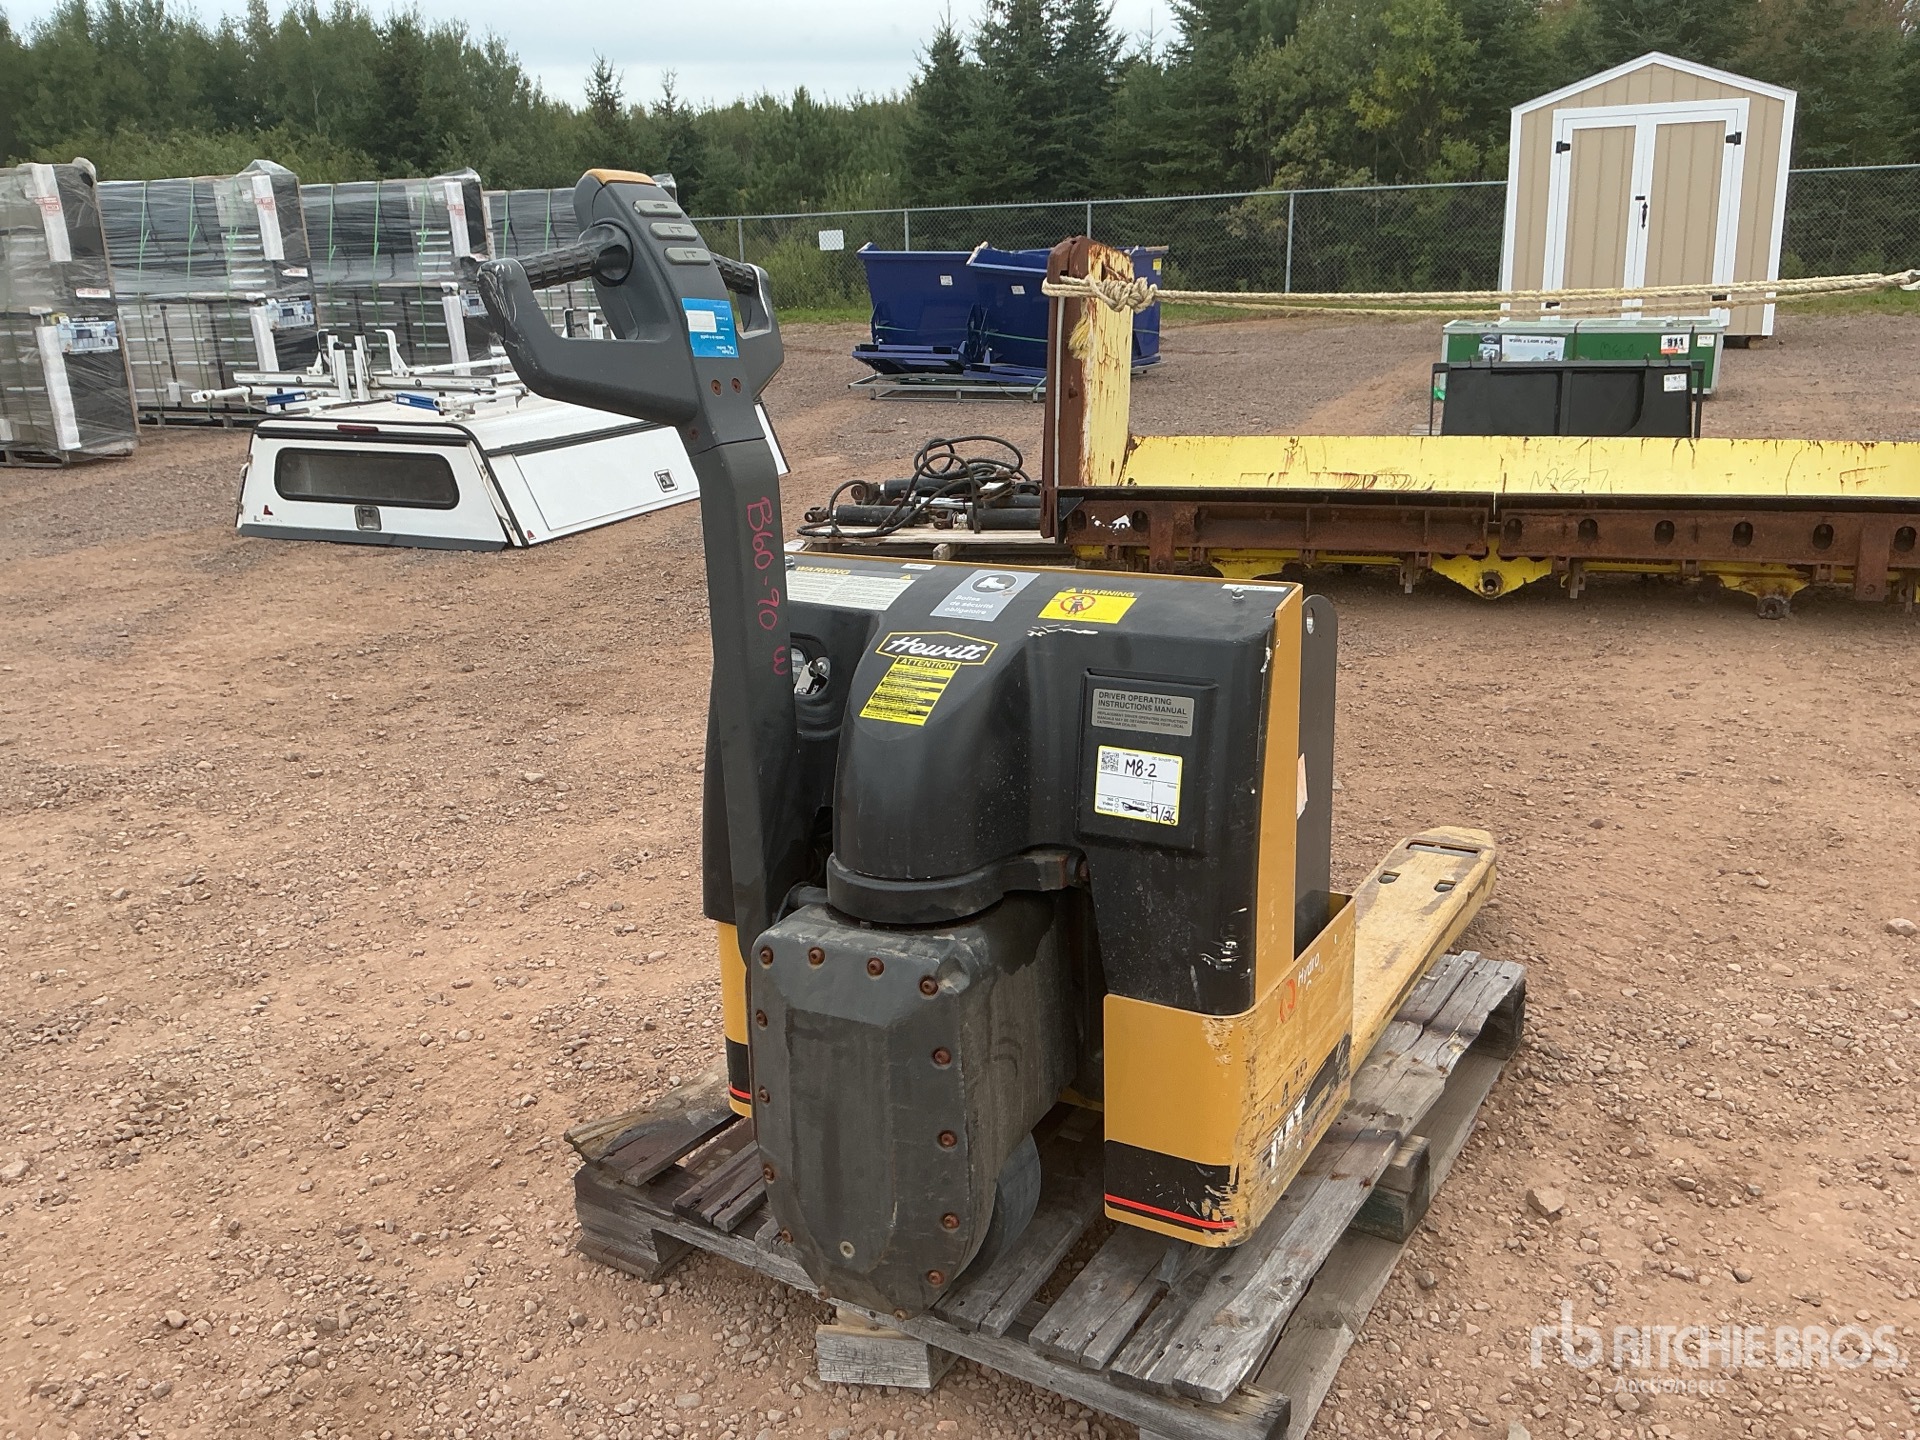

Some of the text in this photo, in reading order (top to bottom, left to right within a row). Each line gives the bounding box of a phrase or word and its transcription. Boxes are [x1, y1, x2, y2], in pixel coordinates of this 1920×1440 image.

[796, 566, 851, 575] WARNING
[955, 594, 981, 602] Bottes
[1081, 587, 1136, 599] WARNING
[944, 607, 987, 615] obligatoire
[884, 636, 988, 660] Hewitt
[901, 658, 955, 670] ATTENTION
[1098, 691, 1172, 706] DRIVER OPERATING
[1098, 699, 1187, 715] INSTRUCTIONS MANUAL
[1125, 758, 1158, 778] M8-2
